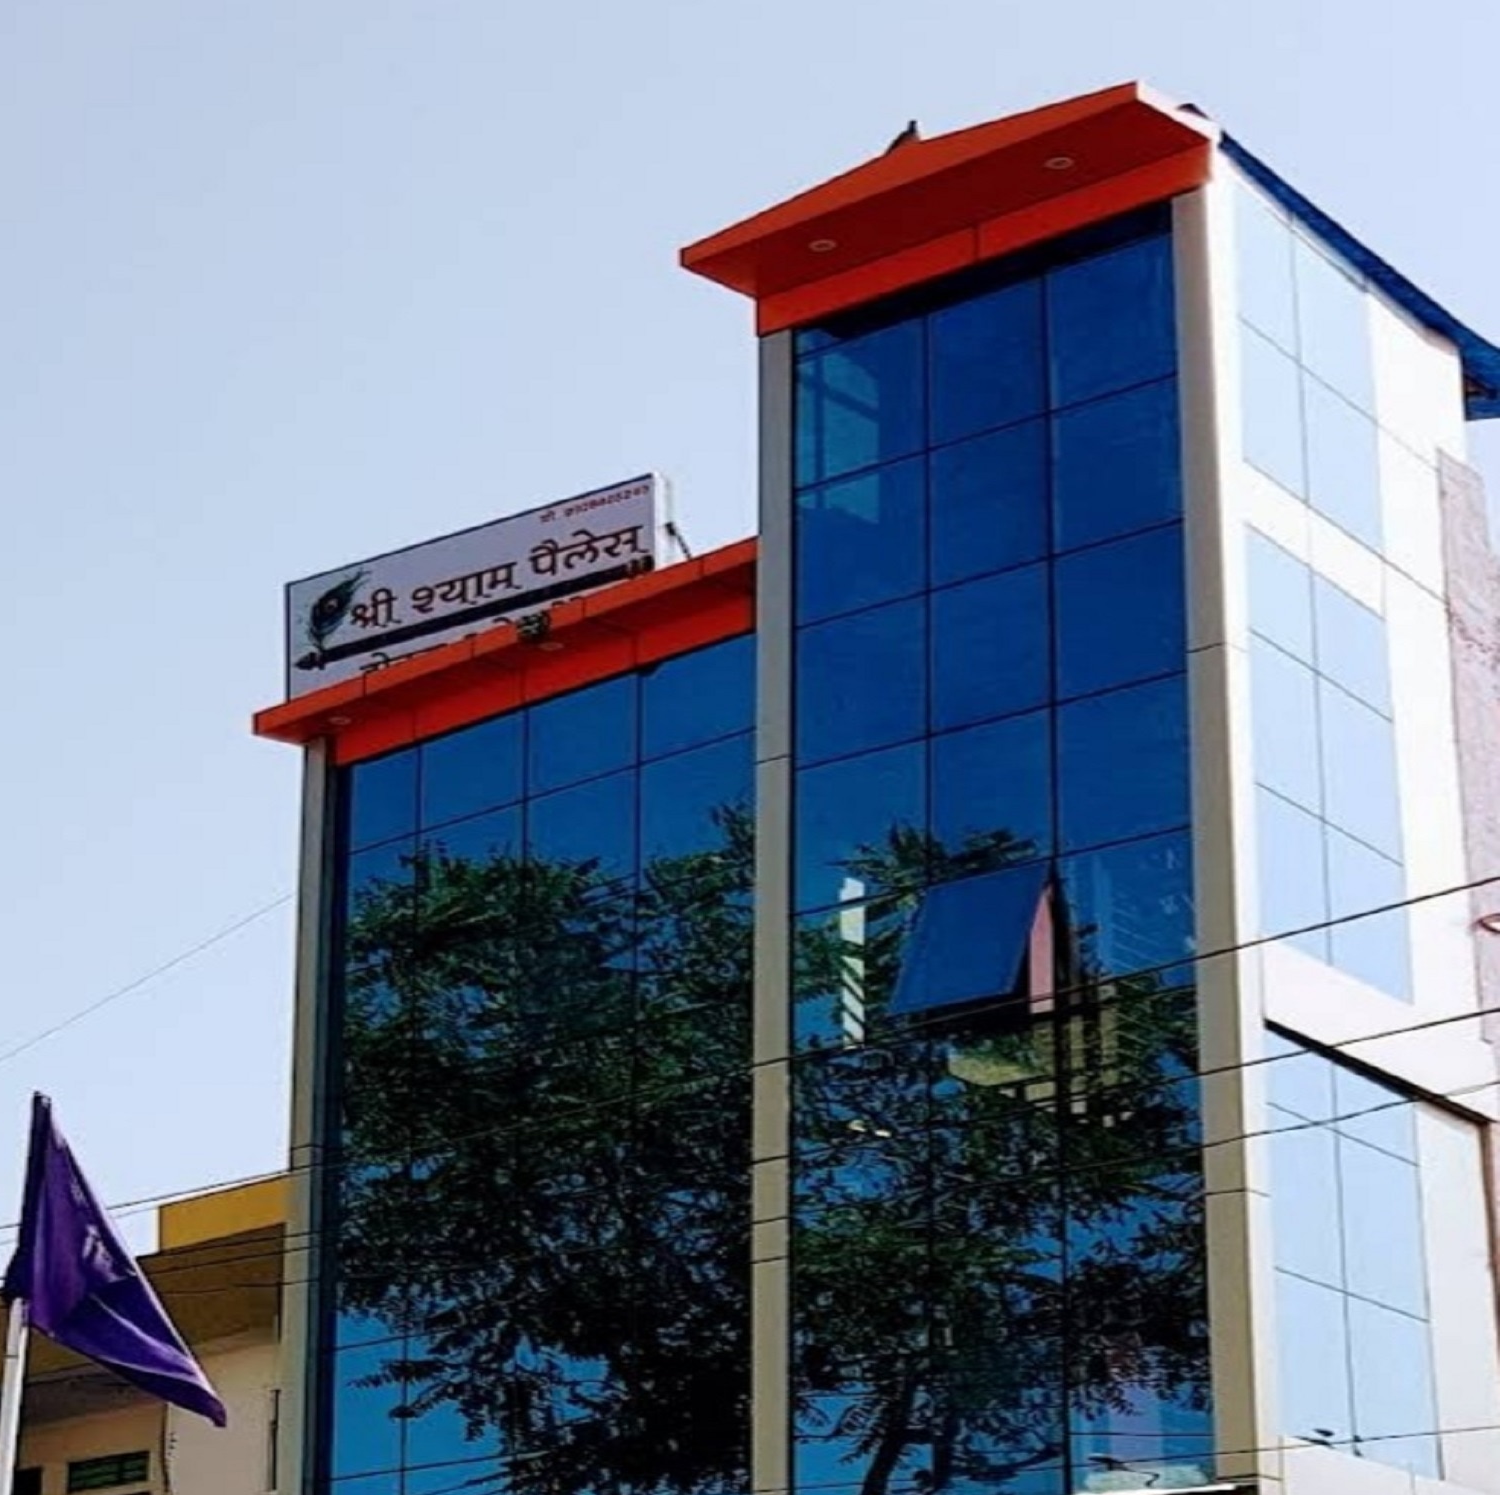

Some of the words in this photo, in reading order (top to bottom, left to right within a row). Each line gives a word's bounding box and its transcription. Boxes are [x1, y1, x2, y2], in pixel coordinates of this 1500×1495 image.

[350, 587, 401, 629] श्री
[410, 561, 521, 613] श्याम
[529, 525, 649, 576] पैलेस
